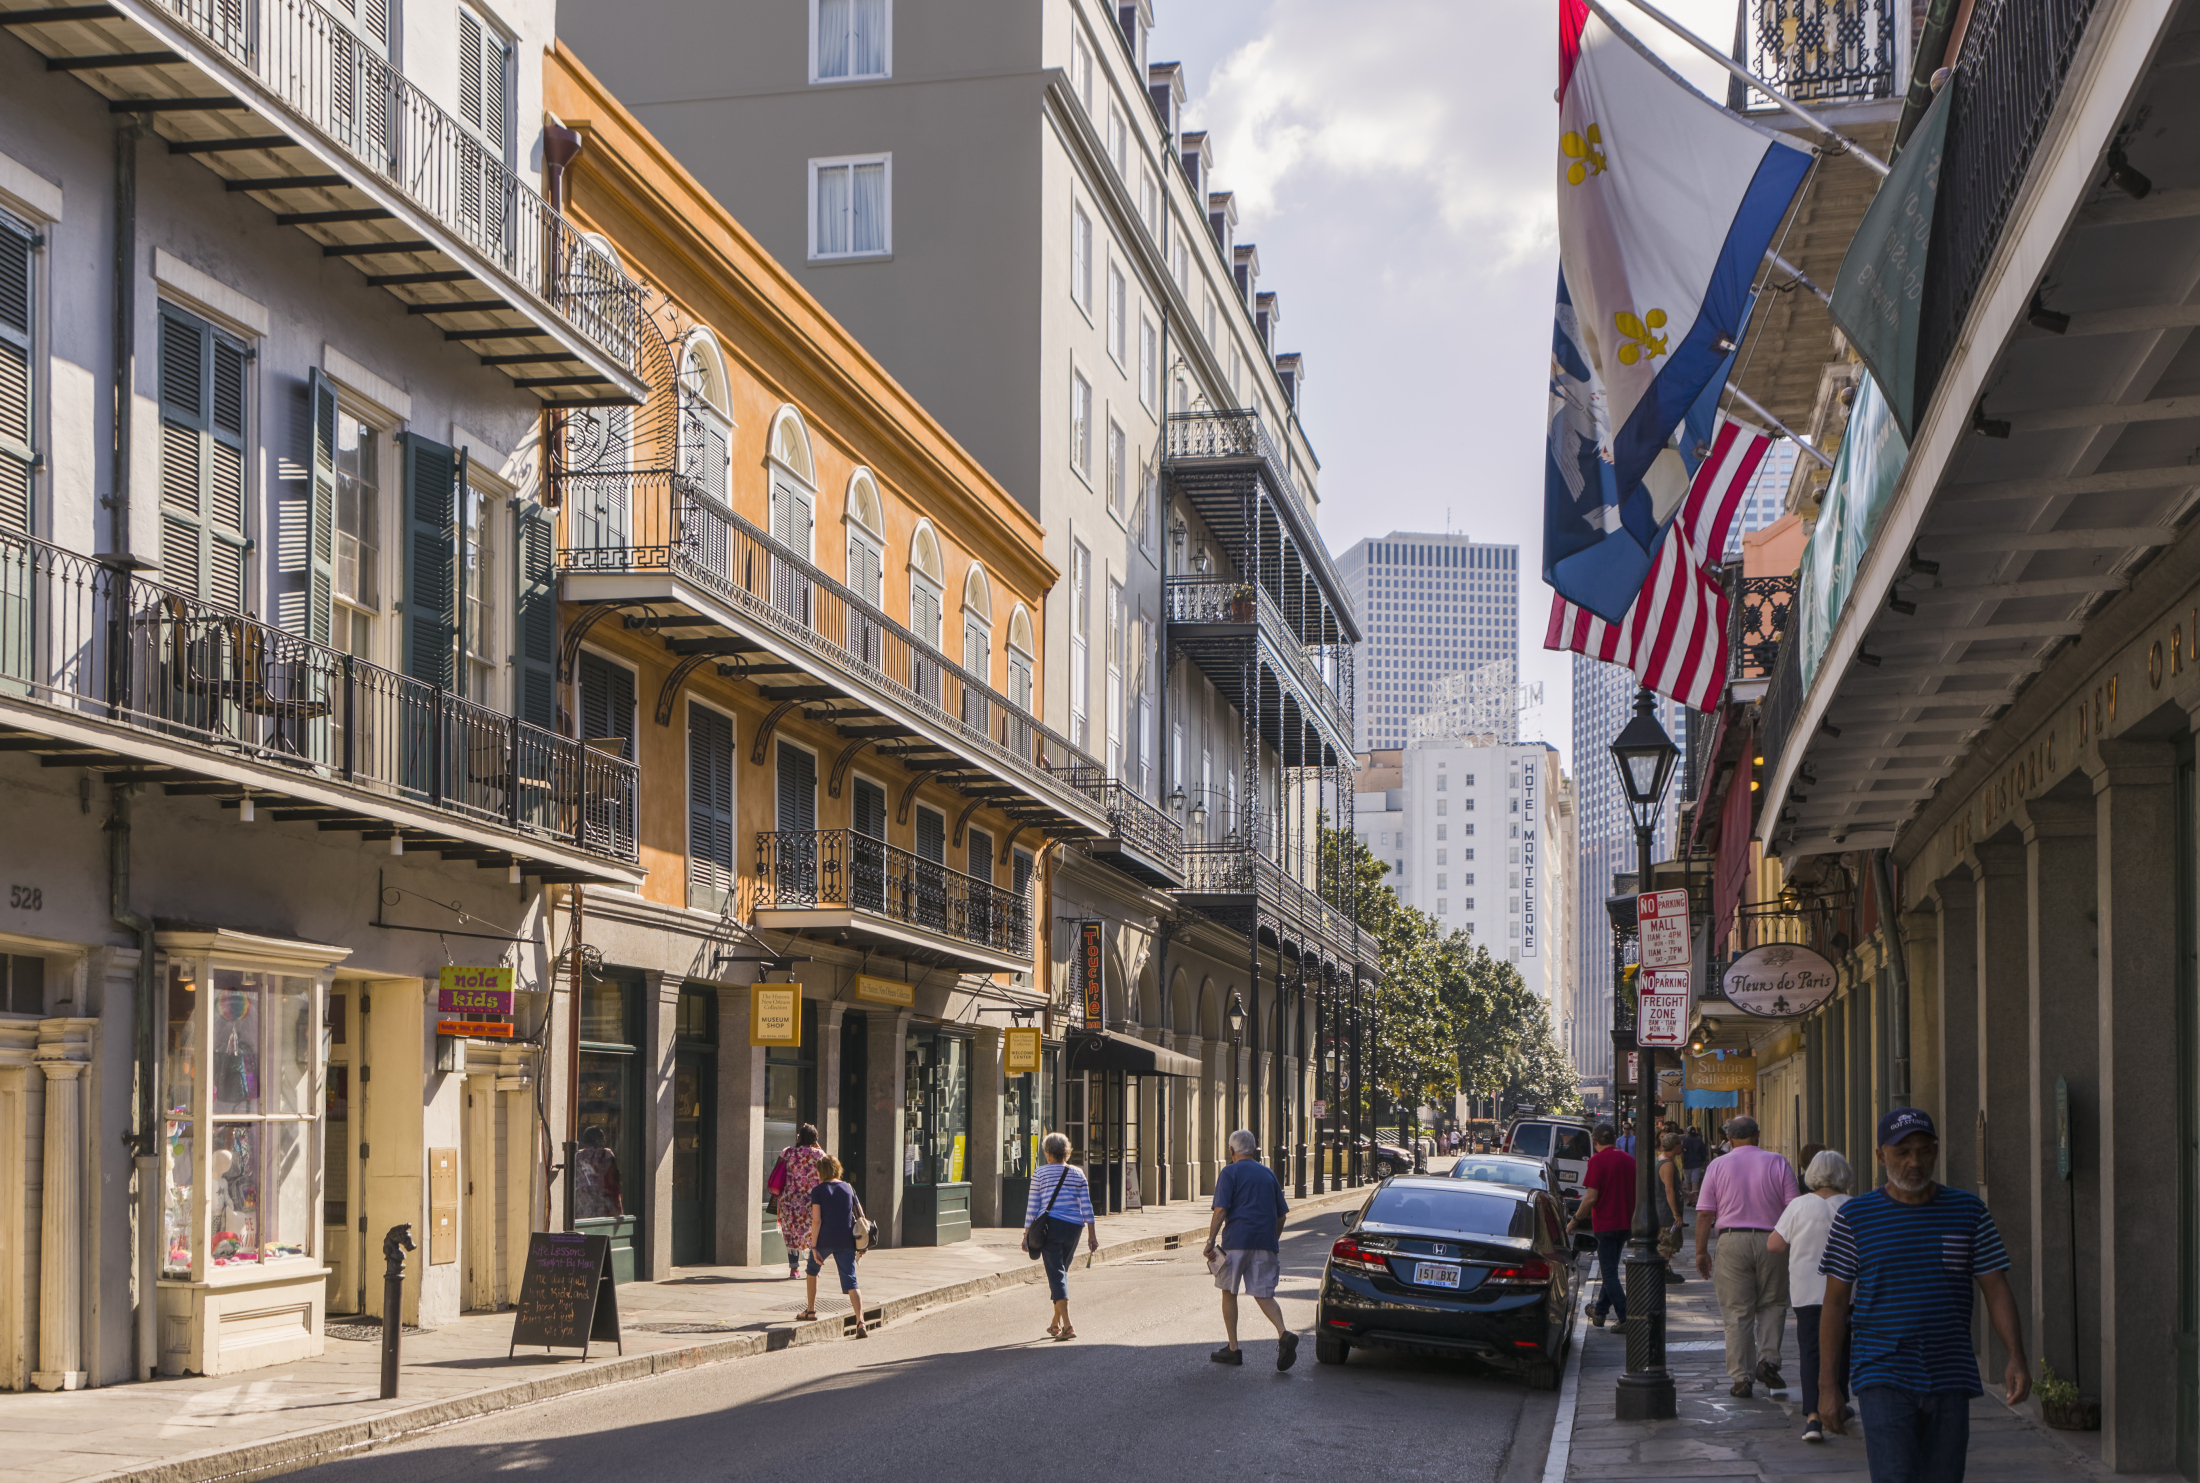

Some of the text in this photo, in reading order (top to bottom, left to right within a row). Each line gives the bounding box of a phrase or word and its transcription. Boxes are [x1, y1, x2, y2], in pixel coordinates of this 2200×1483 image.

[1985, 730, 2055, 828] HISTORIC
[2078, 672, 2119, 748] NEW
[1524, 763, 1534, 947] HOTEL MONTELEONE
[10, 884, 43, 912] 528
[1640, 898, 1685, 914] NO PARKING
[1650, 918, 1677, 932] MALL
[1647, 933, 1660, 941] 11AM
[1668, 931, 1682, 939] 4PM
[1648, 949, 1661, 957] 11AM
[1669, 946, 1683, 954] 7PM
[454, 971, 498, 988] nola
[1083, 931, 1101, 1015] Touch'e
[1641, 975, 1687, 990] NO PARKING
[1729, 971, 1831, 994] Fleur de Paris
[452, 991, 499, 1008] kids
[1643, 996, 1684, 1007] FREIGHT
[1650, 1008, 1676, 1019] ZONE
[1086, 1021, 1102, 1029] BAR
[1698, 1061, 1743, 1073] Sutton
[1691, 1073, 1751, 1085] Galleries
[551, 1243, 586, 1257] Lessons
[566, 1257, 576, 1275] By
[1419, 1268, 1458, 1282] 151 BXZ
